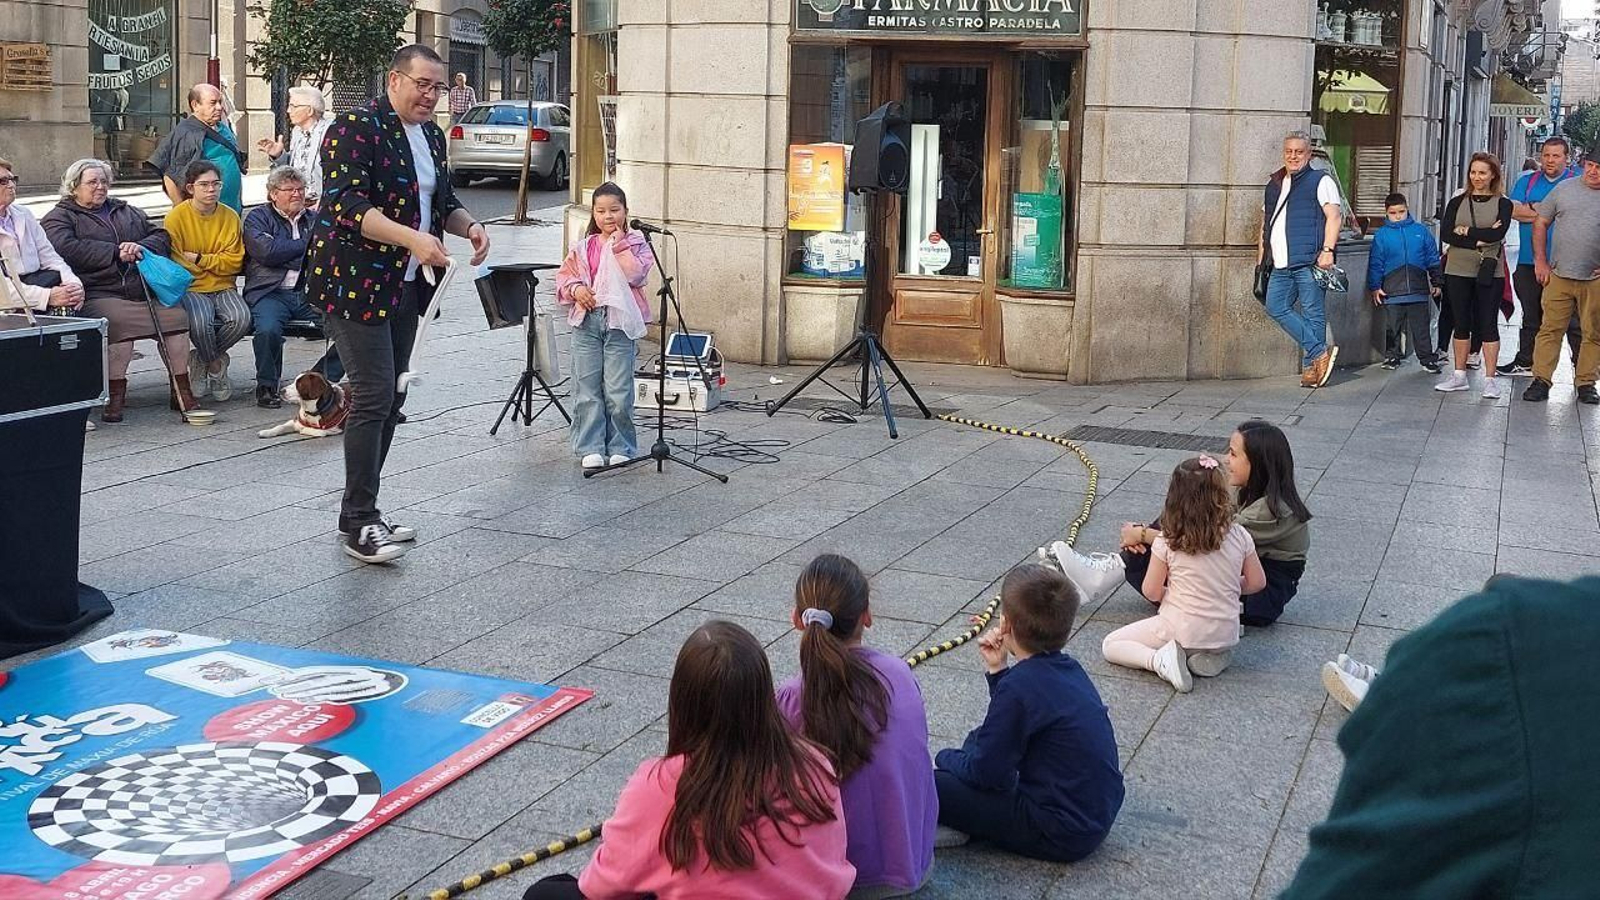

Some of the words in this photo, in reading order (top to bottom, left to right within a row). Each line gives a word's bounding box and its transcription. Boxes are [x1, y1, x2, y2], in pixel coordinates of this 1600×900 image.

[108, 18, 115, 30] A
[868, 16, 926, 27] ERMITAS
[989, 18, 1061, 29] PARADELA
[89, 74, 133, 88] FRUTOS
[138, 56, 171, 80] SECOS
[1494, 106, 1546, 116] JOYERIA
[46, 767, 71, 781] DE
[293, 834, 349, 867] MERCADO
[347, 817, 376, 838] TEIS
[79, 867, 130, 893] ABRIL
